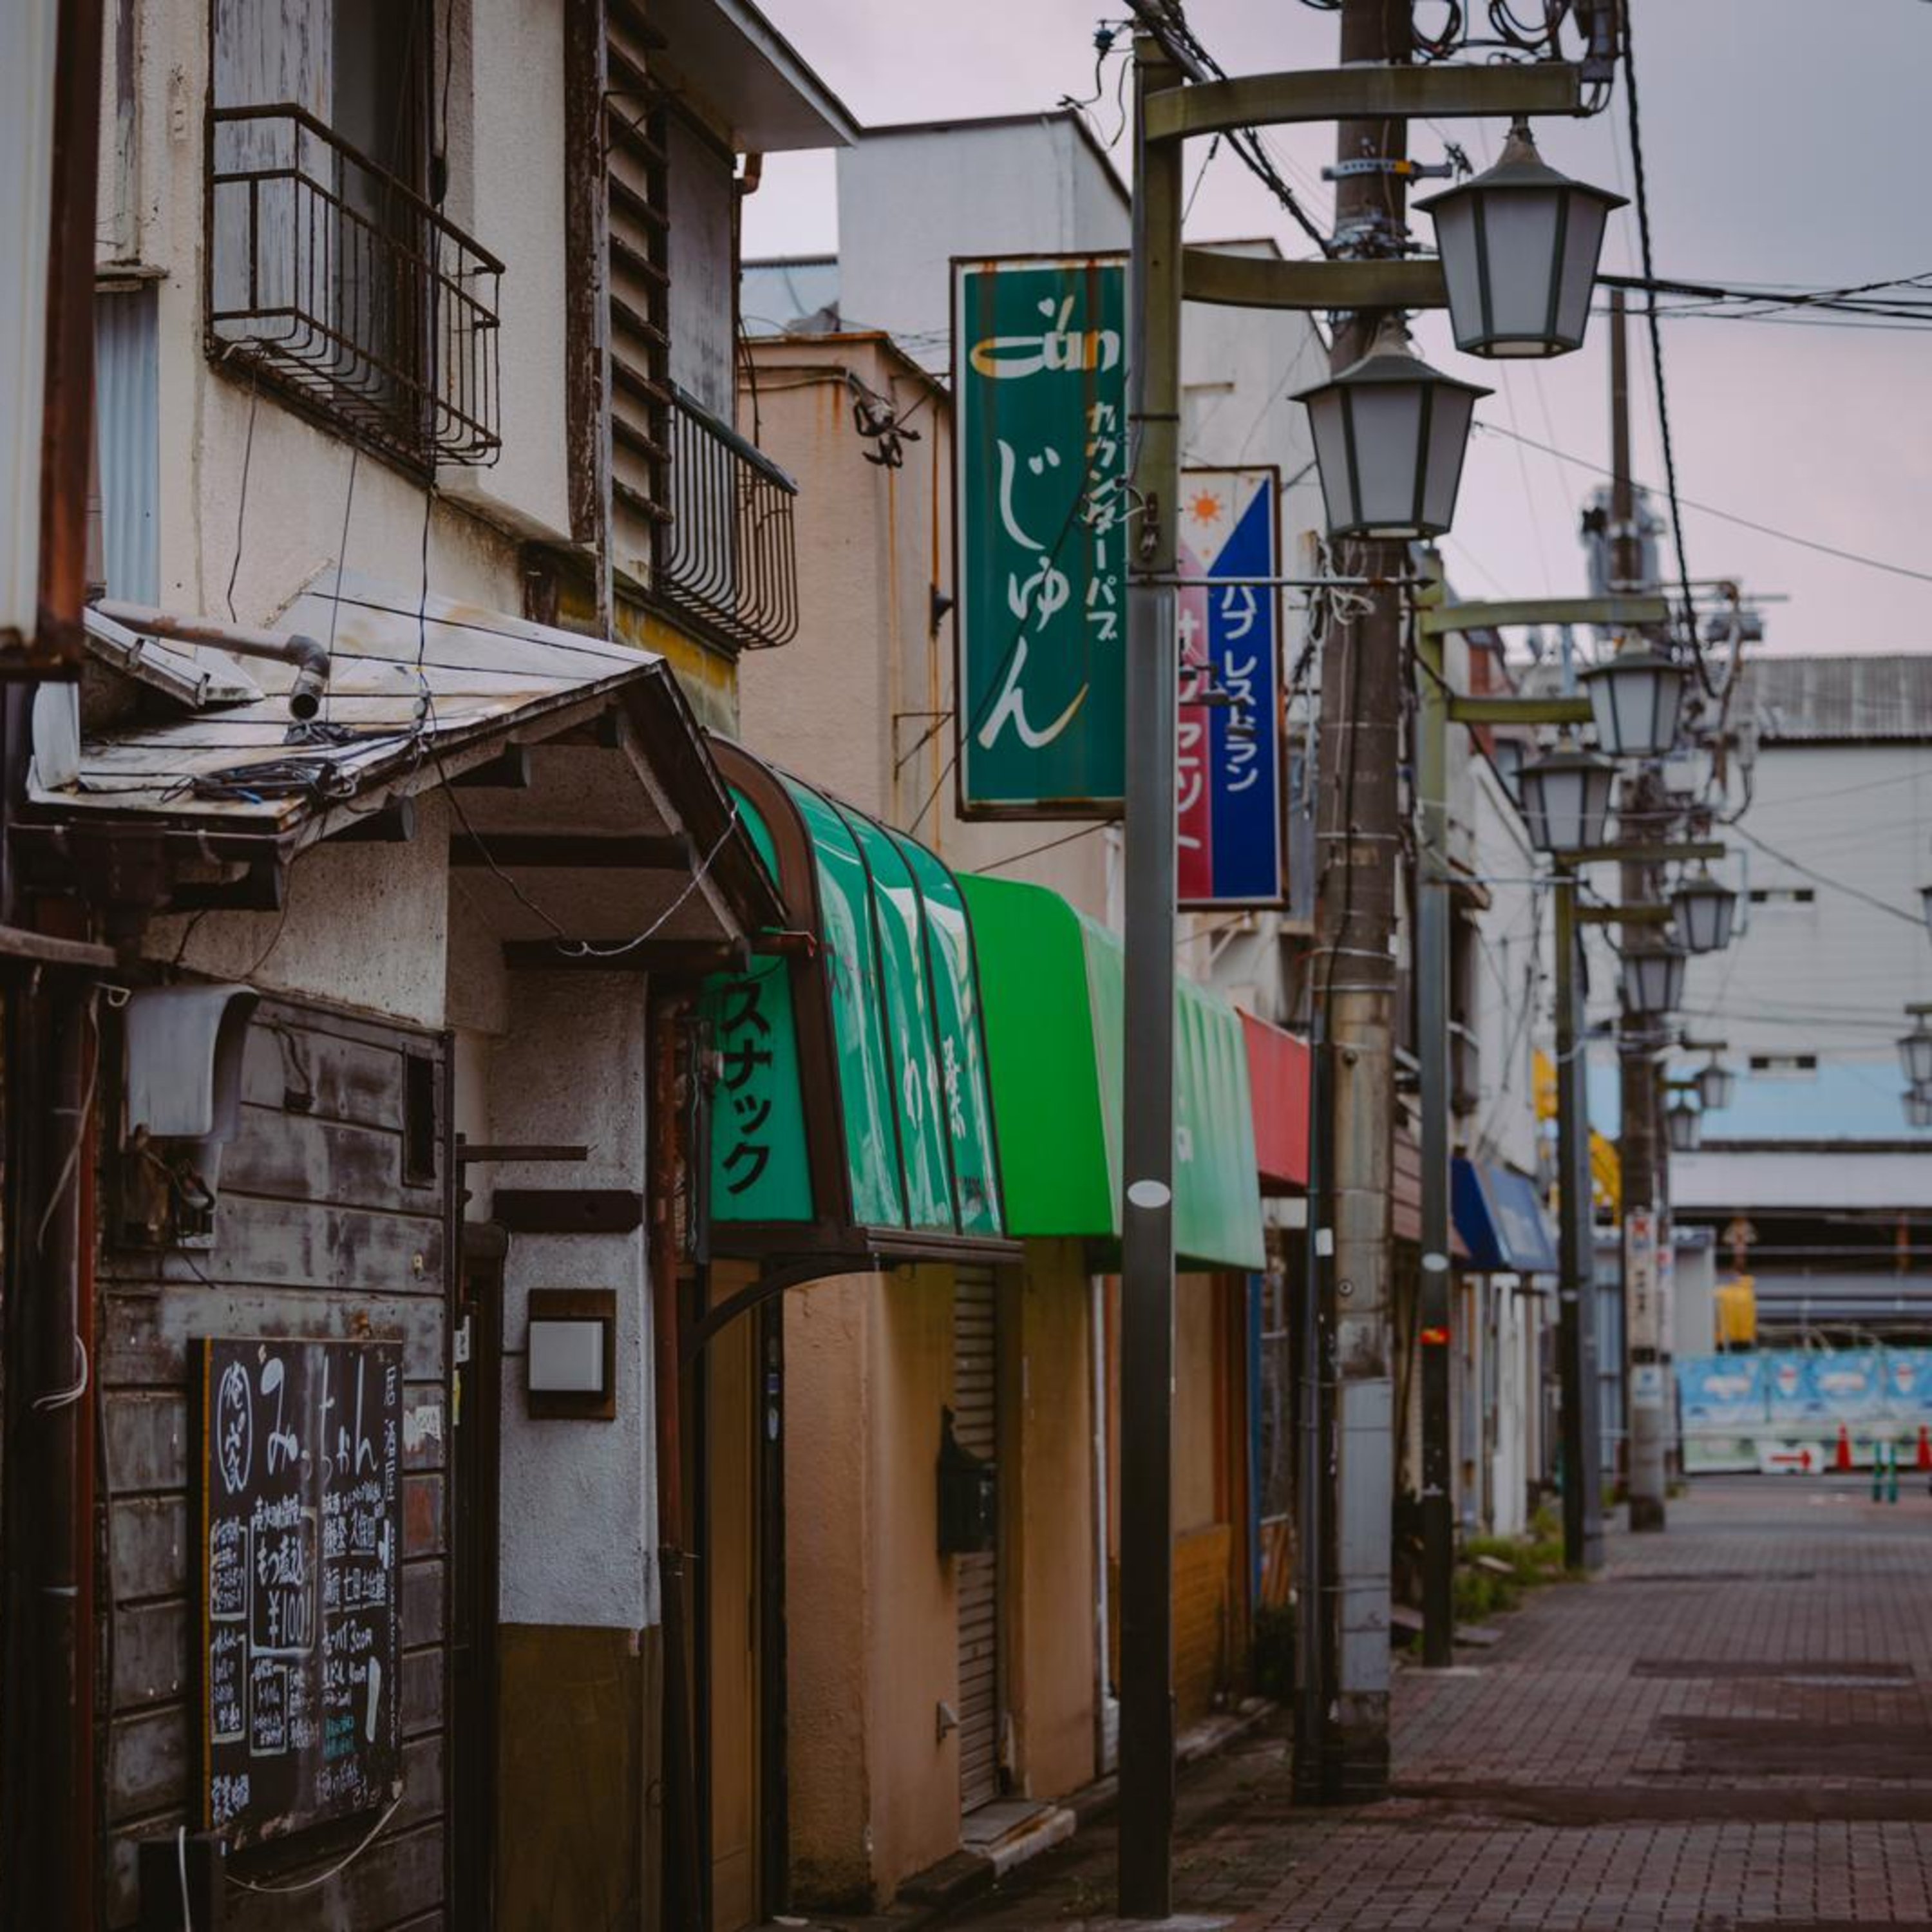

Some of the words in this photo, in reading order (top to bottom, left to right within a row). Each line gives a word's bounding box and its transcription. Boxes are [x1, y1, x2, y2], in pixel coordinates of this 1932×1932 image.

[978, 437, 1089, 750] じゅん
[721, 981, 772, 1195] スナック
